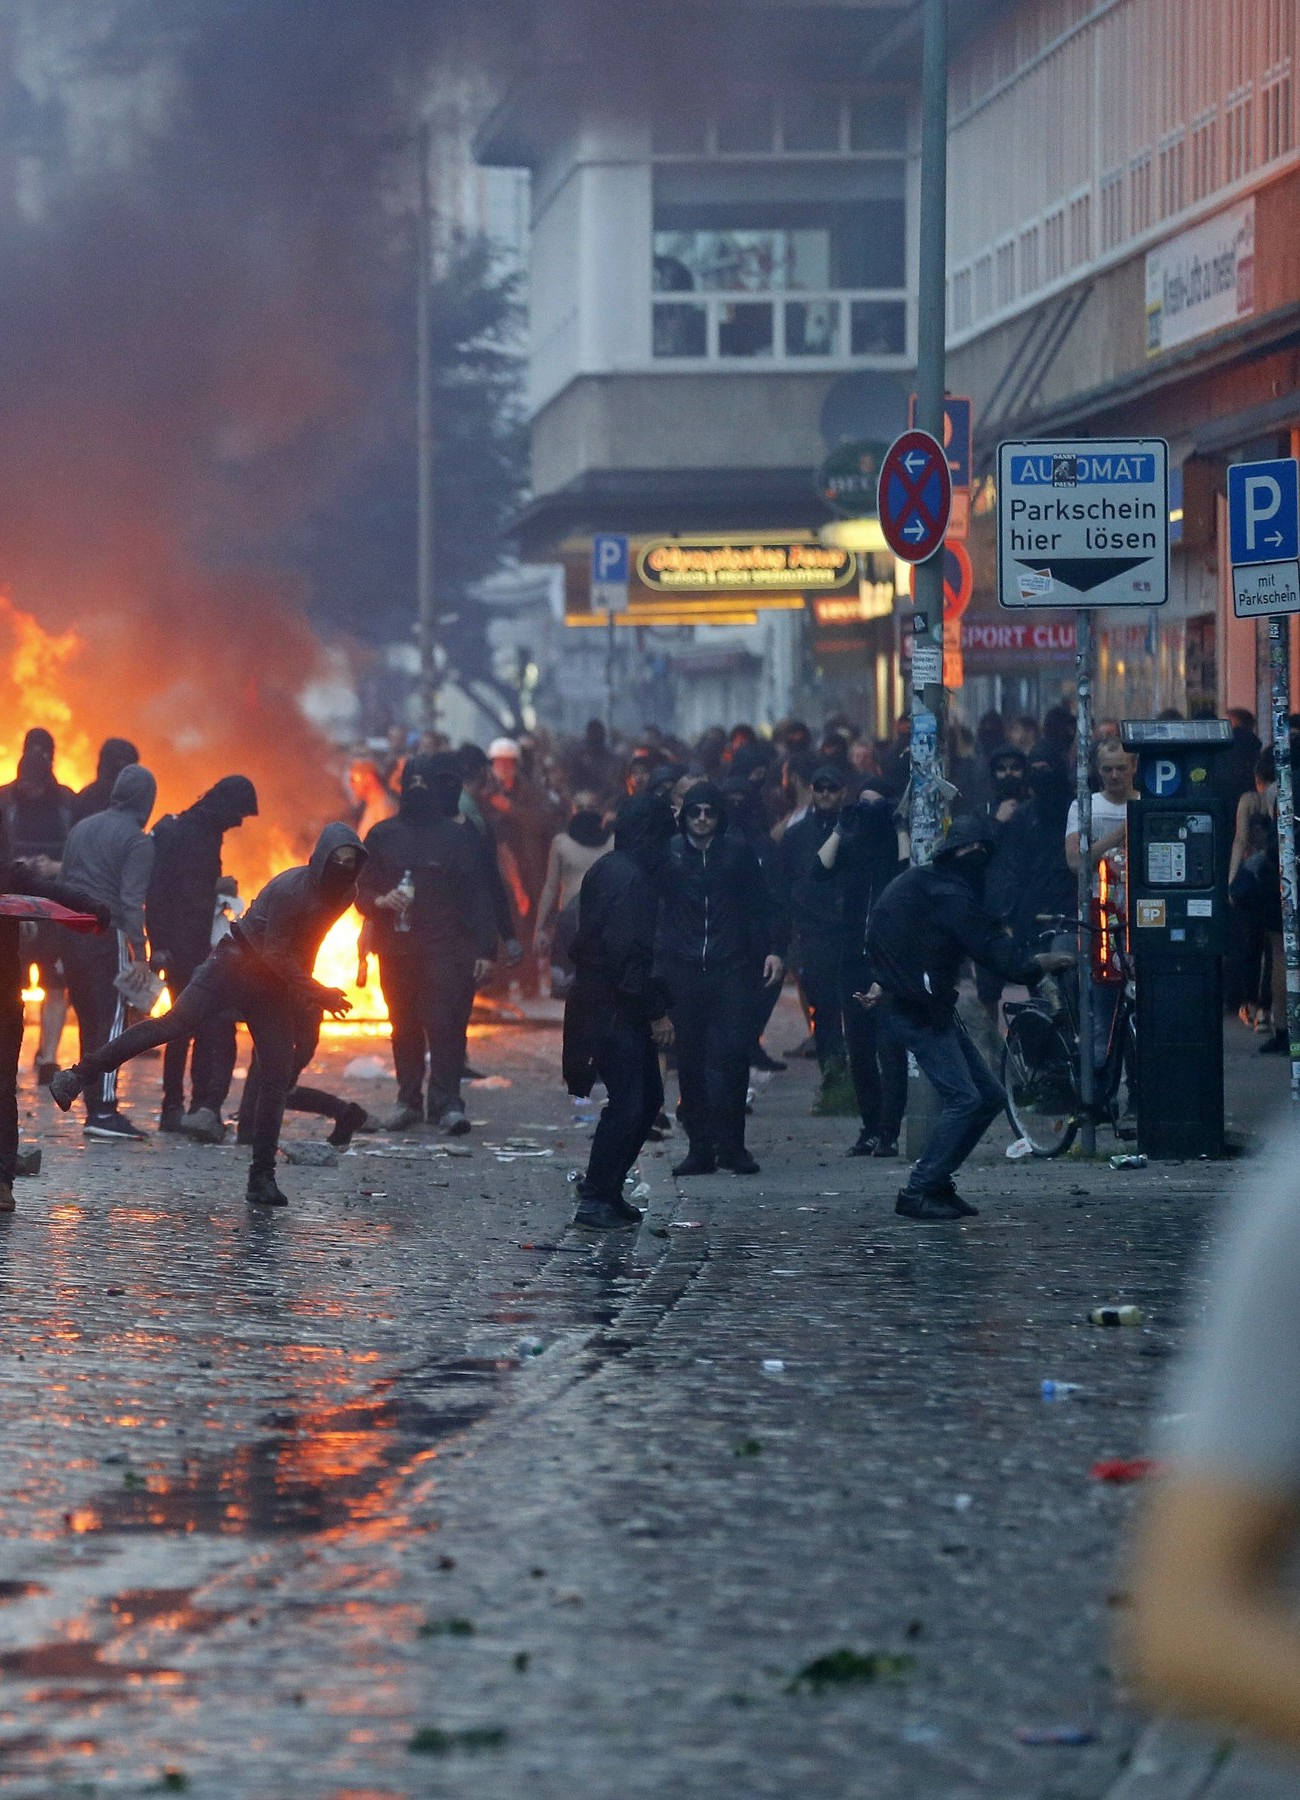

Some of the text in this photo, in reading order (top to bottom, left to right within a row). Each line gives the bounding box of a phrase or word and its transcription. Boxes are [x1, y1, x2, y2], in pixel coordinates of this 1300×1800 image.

[1020, 457, 1146, 482] AUOMAT
[1011, 498, 1156, 520] Parkschein
[1245, 476, 1281, 550] P
[1011, 528, 1156, 550] hier lösen
[601, 541, 621, 577] P
[1258, 574, 1275, 587] mit
[1239, 590, 1296, 606] Parkschein
[1033, 625, 1074, 648] CLU
[1155, 760, 1176, 794] P
